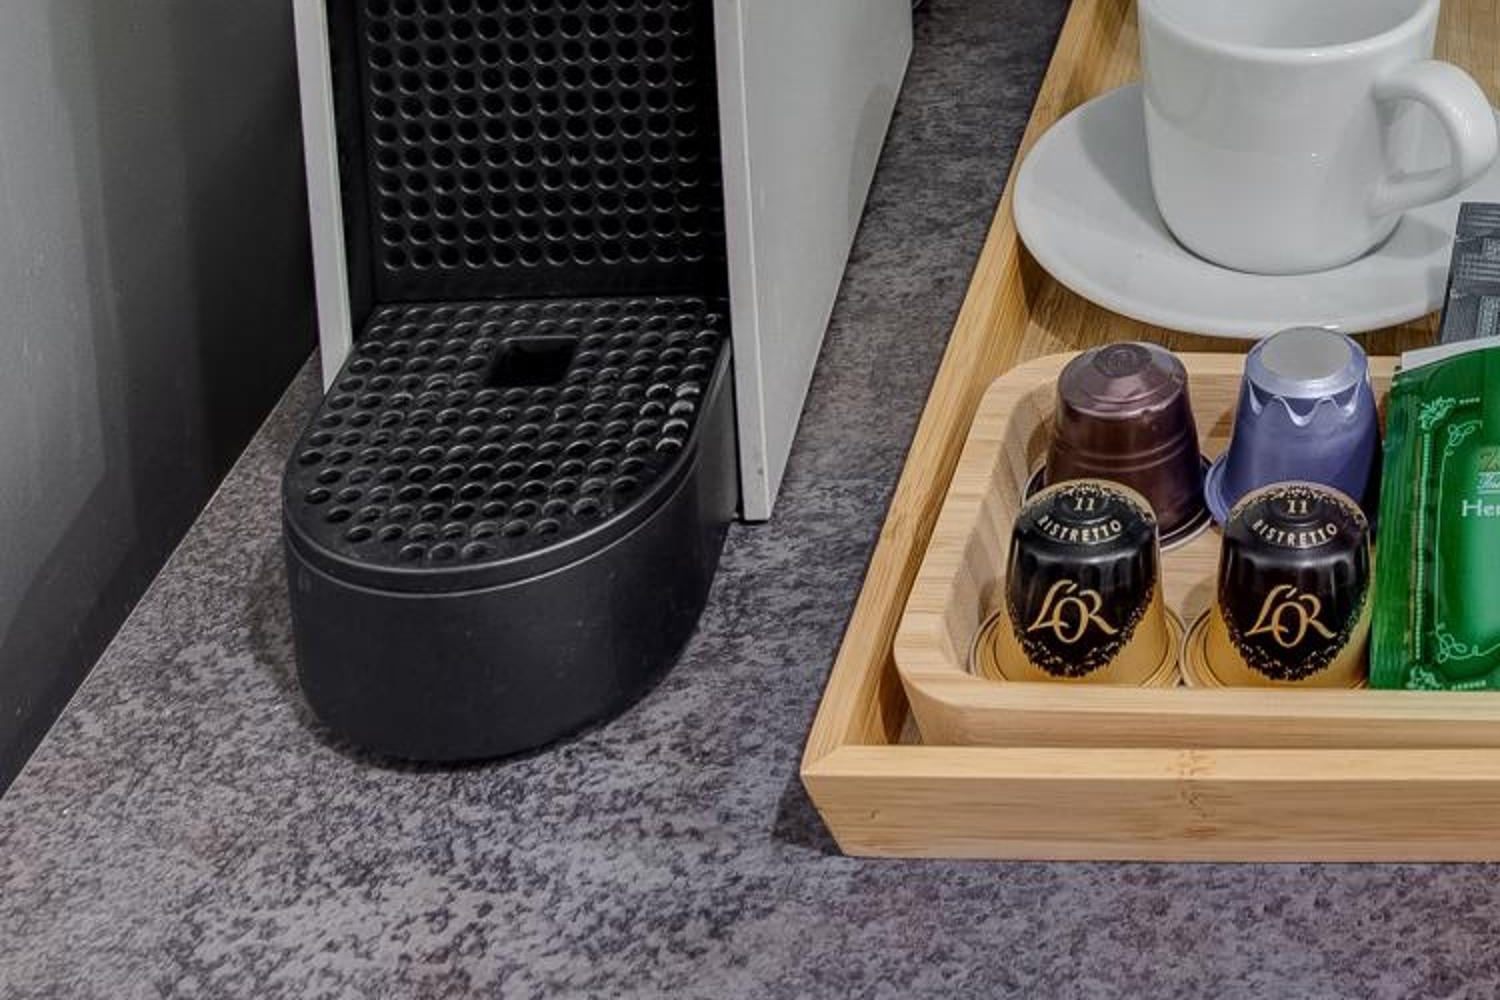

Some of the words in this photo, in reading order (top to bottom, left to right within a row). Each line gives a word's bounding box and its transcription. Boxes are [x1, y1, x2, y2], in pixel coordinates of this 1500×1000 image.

[1072, 497, 1096, 512] 11
[1286, 499, 1309, 514] 11
[1036, 515, 1122, 542] RISTRETTO
[1251, 519, 1338, 547] RISTRETTO
